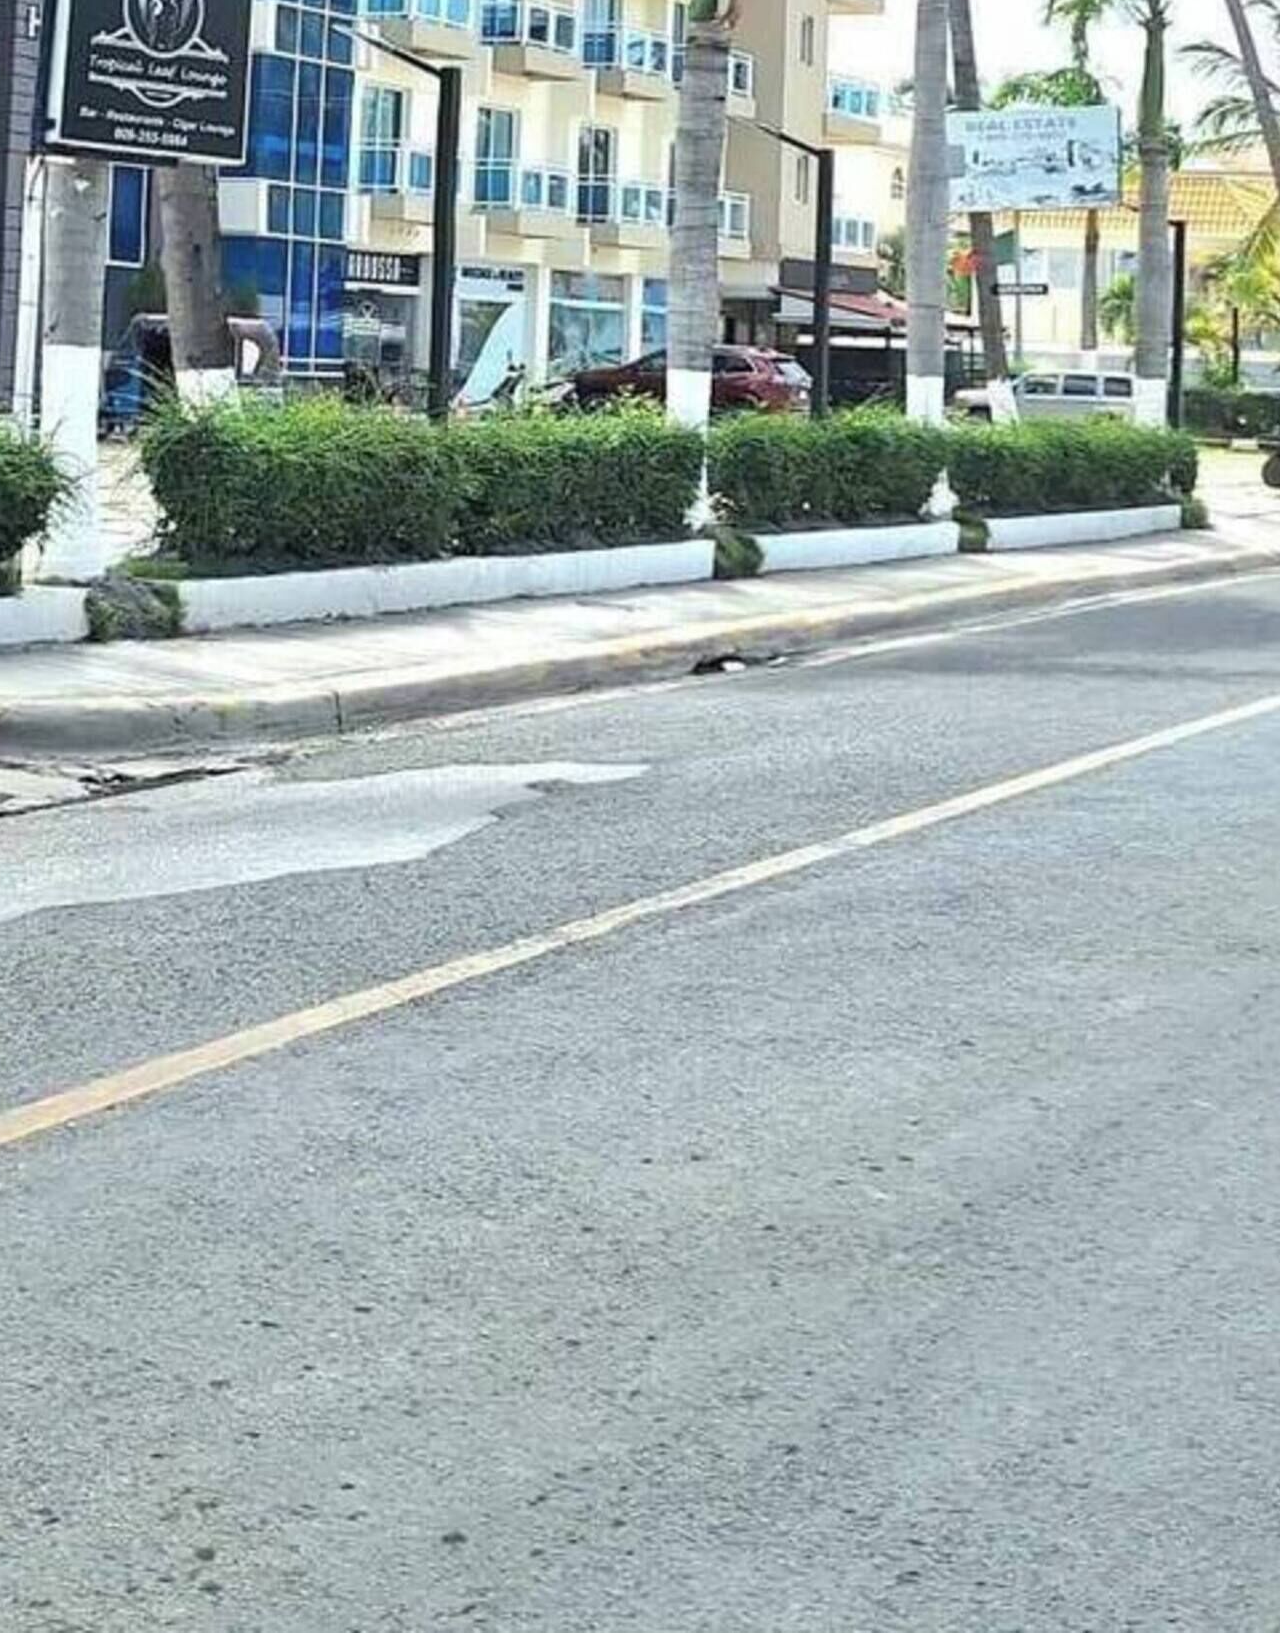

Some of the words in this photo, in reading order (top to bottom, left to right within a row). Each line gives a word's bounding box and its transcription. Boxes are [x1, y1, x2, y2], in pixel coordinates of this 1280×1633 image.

[89, 54, 144, 73] Tropical
[147, 61, 178, 80] Leaf
[180, 66, 228, 87] Lounge
[199, 120, 236, 137] Lounge
